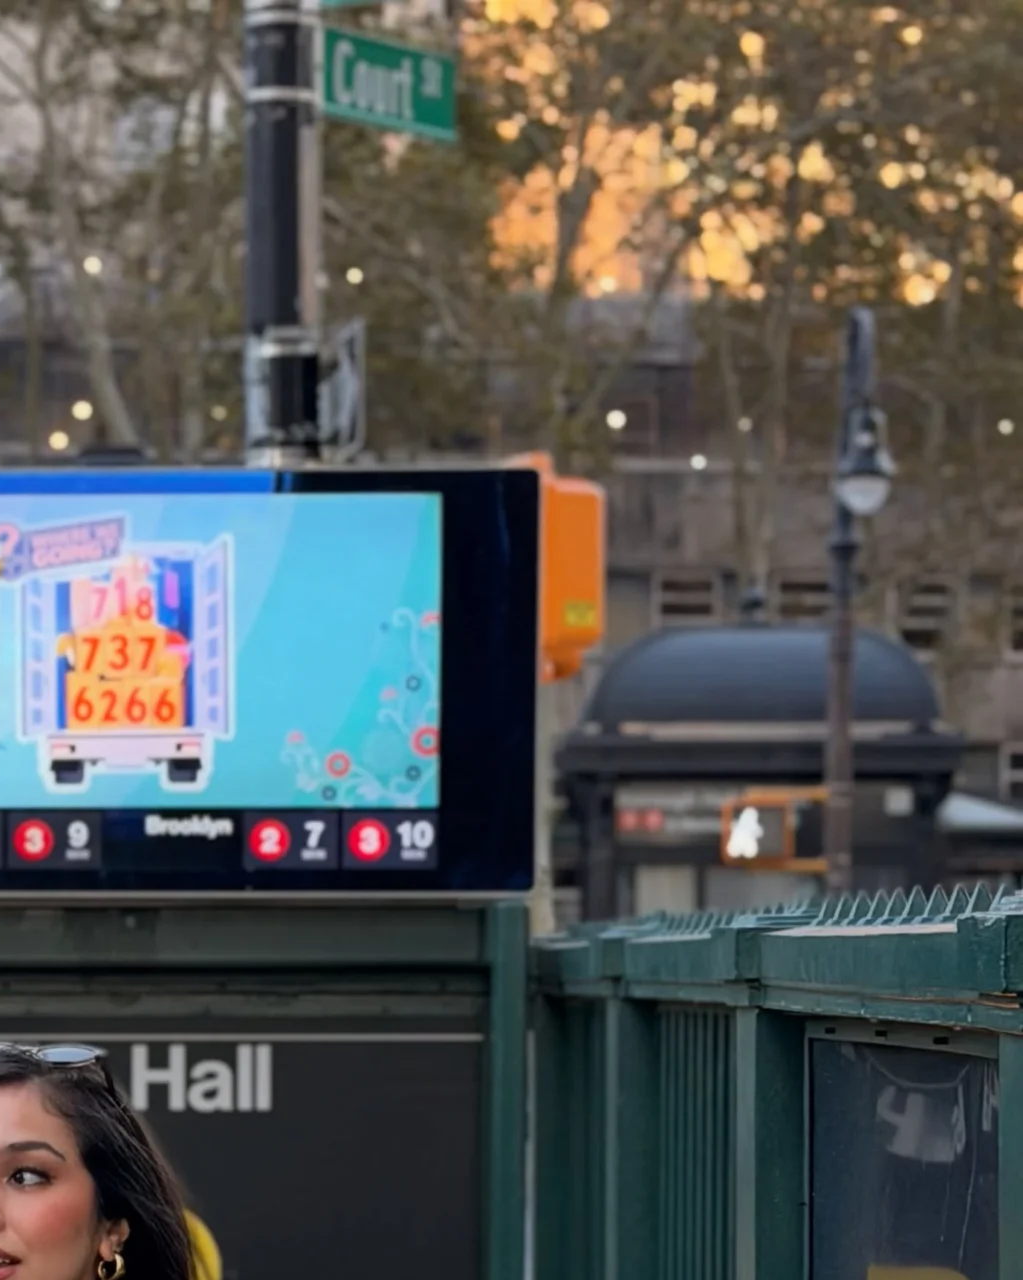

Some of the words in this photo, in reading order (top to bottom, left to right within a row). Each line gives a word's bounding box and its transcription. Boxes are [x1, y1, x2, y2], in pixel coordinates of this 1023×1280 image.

[332, 39, 414, 121] Court
[91, 577, 153, 621] 718
[81, 634, 157, 673] 737
[72, 686, 177, 723] 6266
[23, 826, 45, 853] 3
[67, 820, 89, 849] 9
[259, 826, 281, 854] 2
[304, 820, 326, 849] 7
[358, 826, 381, 854] 3
[396, 819, 435, 849] 10
[130, 1043, 273, 1113] Hall
